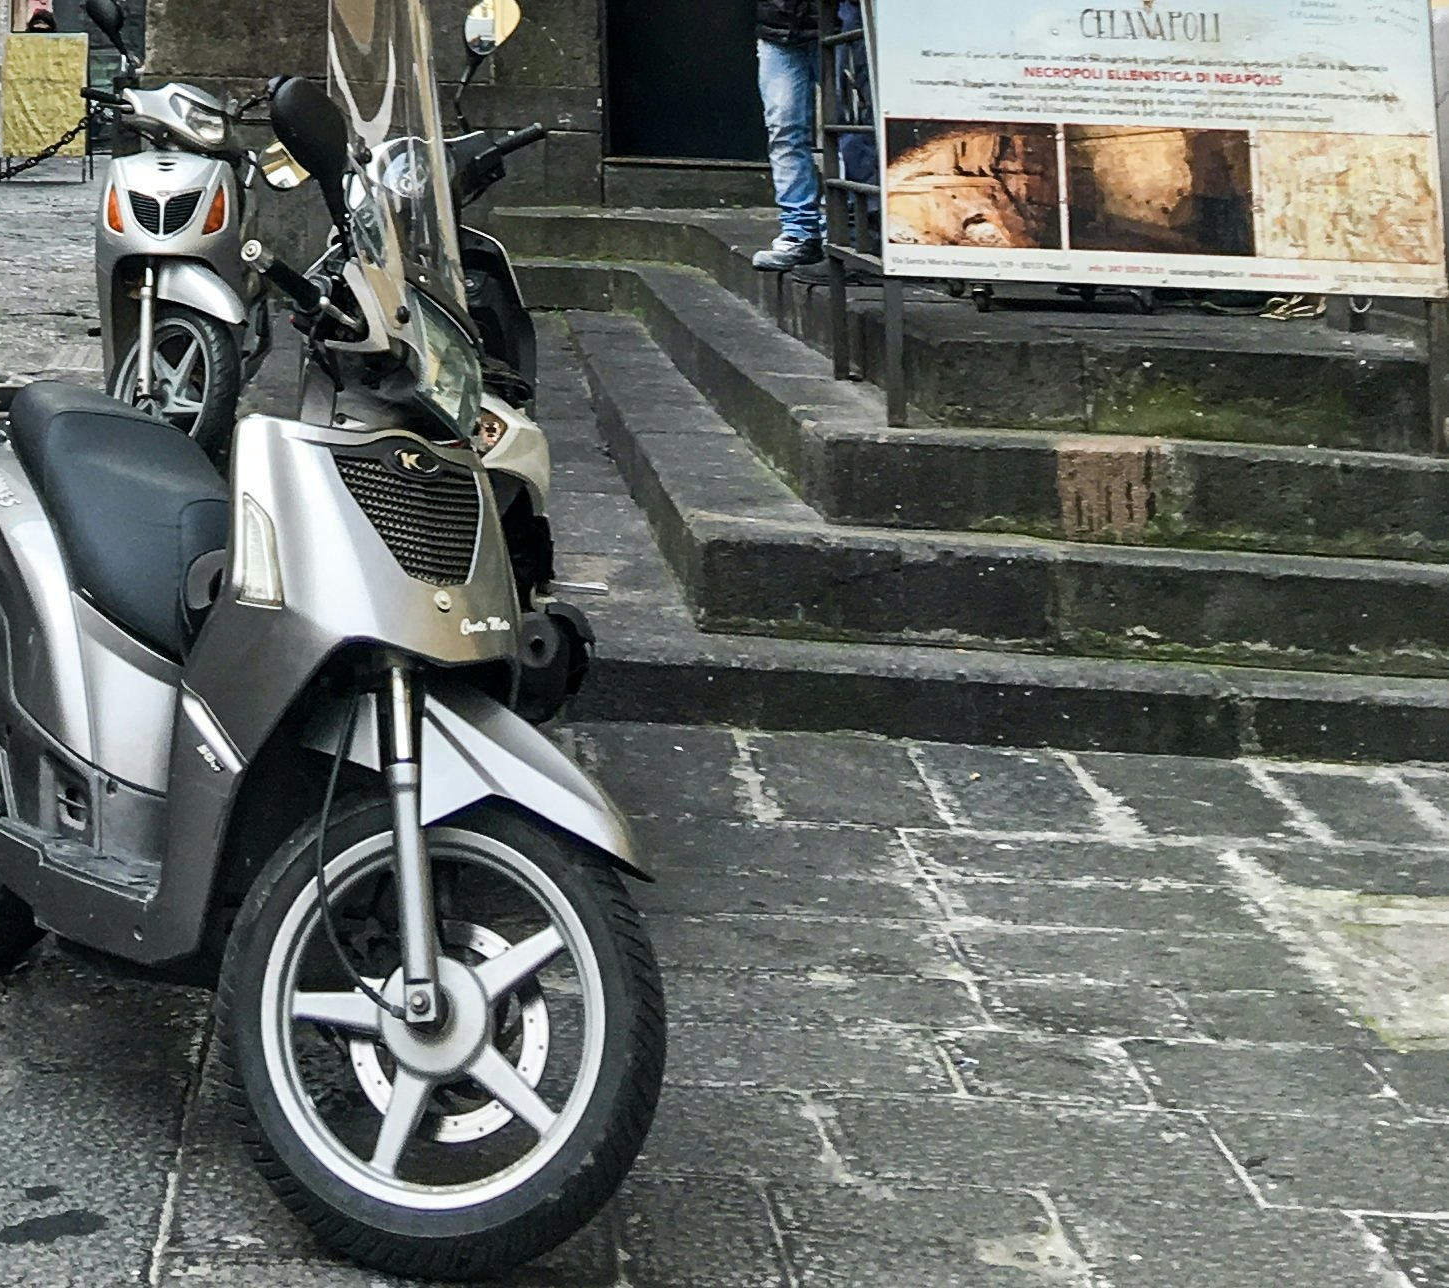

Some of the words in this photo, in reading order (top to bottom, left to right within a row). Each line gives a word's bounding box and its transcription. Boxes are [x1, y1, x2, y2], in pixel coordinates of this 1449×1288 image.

[1079, 8, 1221, 43] CELANAPOLI
[1023, 67, 1102, 80] NECROPOLI
[1107, 69, 1193, 83] ELLENISTICA
[1196, 72, 1211, 83] DI
[1214, 73, 1284, 86] NEAPOLIS
